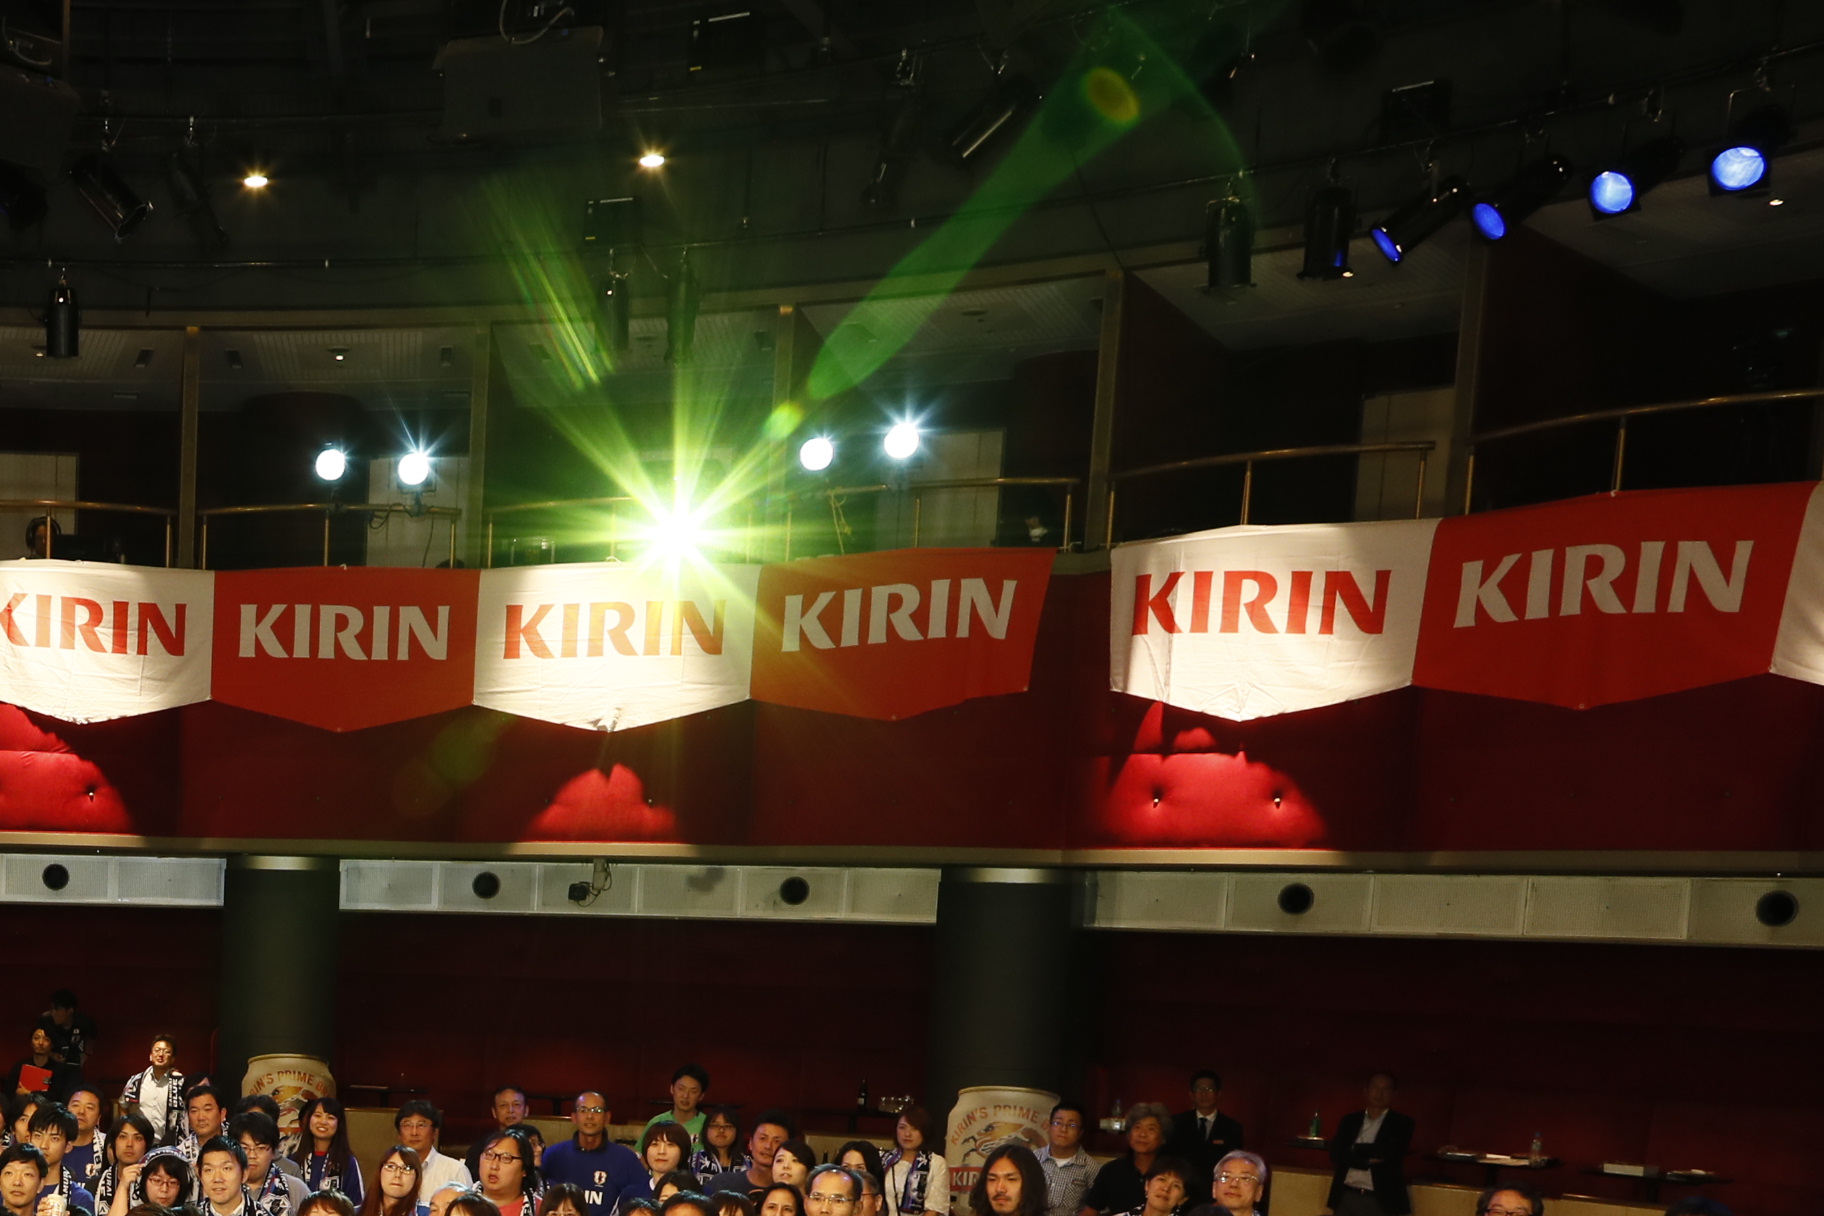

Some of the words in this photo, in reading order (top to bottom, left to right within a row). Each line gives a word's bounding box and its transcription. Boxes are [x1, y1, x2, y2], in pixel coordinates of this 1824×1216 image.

[1132, 569, 1392, 637] KIRIN
[1453, 539, 1754, 628] KIRIN
[239, 602, 451, 661] KIRIN
[503, 599, 726, 660] KIRIN
[781, 578, 1018, 653] KIRIN
[277, 1070, 314, 1086] PRIME
[951, 1107, 989, 1146] KIRIN'S
[993, 1105, 1041, 1123] PRIME
